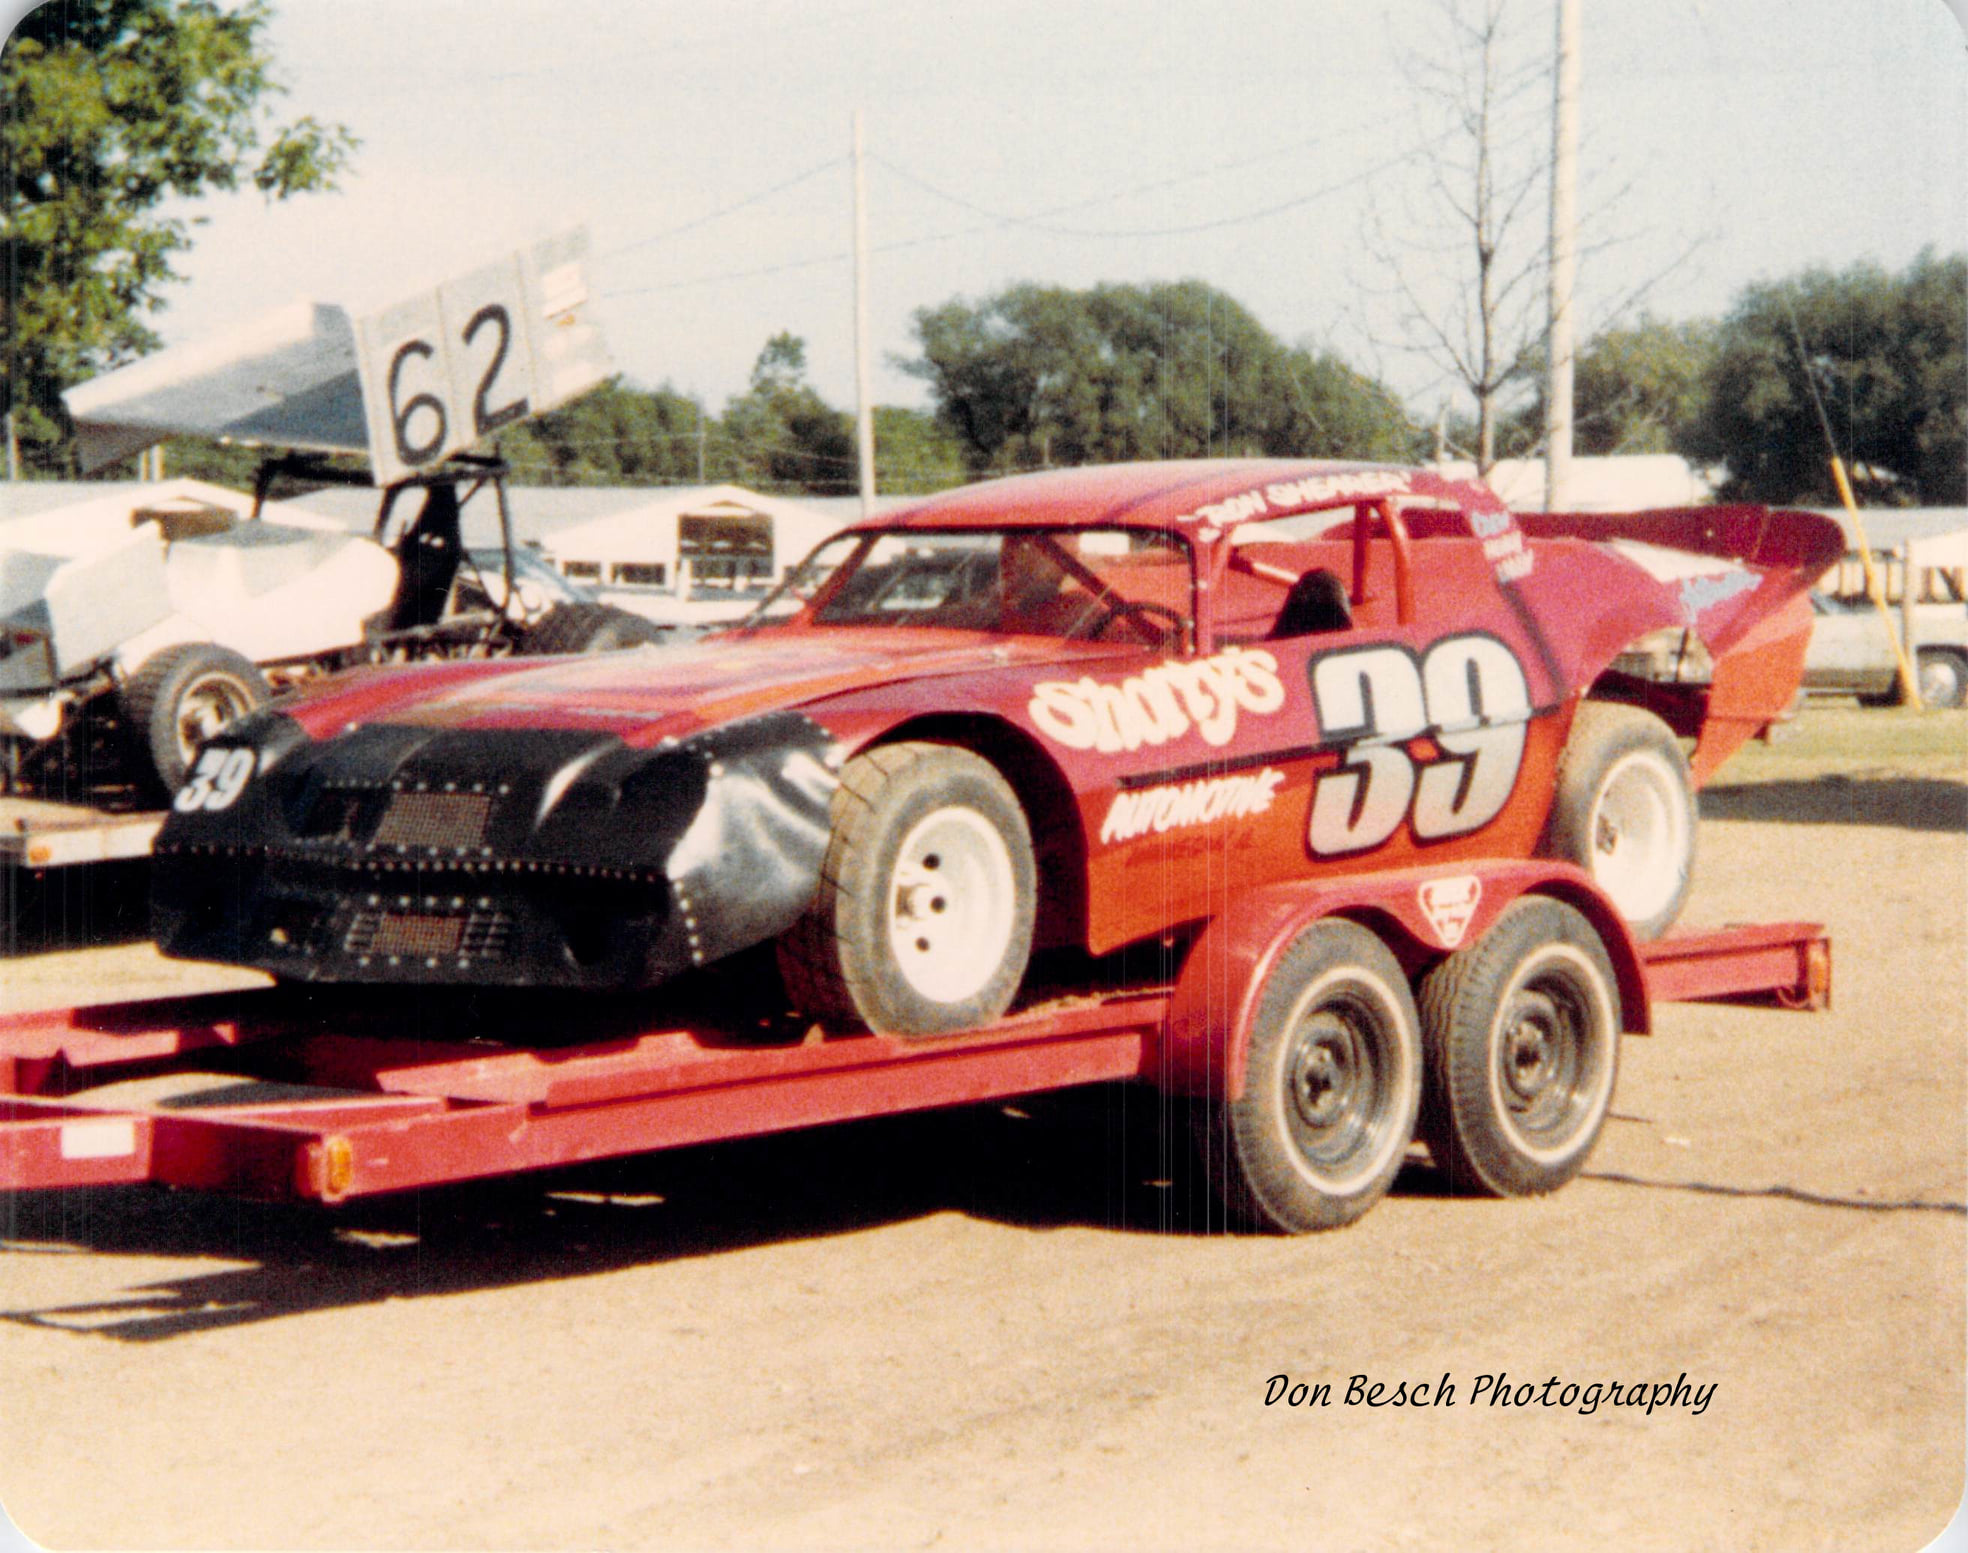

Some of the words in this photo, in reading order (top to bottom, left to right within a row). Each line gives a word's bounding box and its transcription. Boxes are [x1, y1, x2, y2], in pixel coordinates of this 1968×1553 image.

[386, 303, 530, 467] 62
[173, 747, 256, 813] 39
[1100, 767, 1285, 844] AUTOMOTIVE
[1306, 629, 1532, 863] 39
